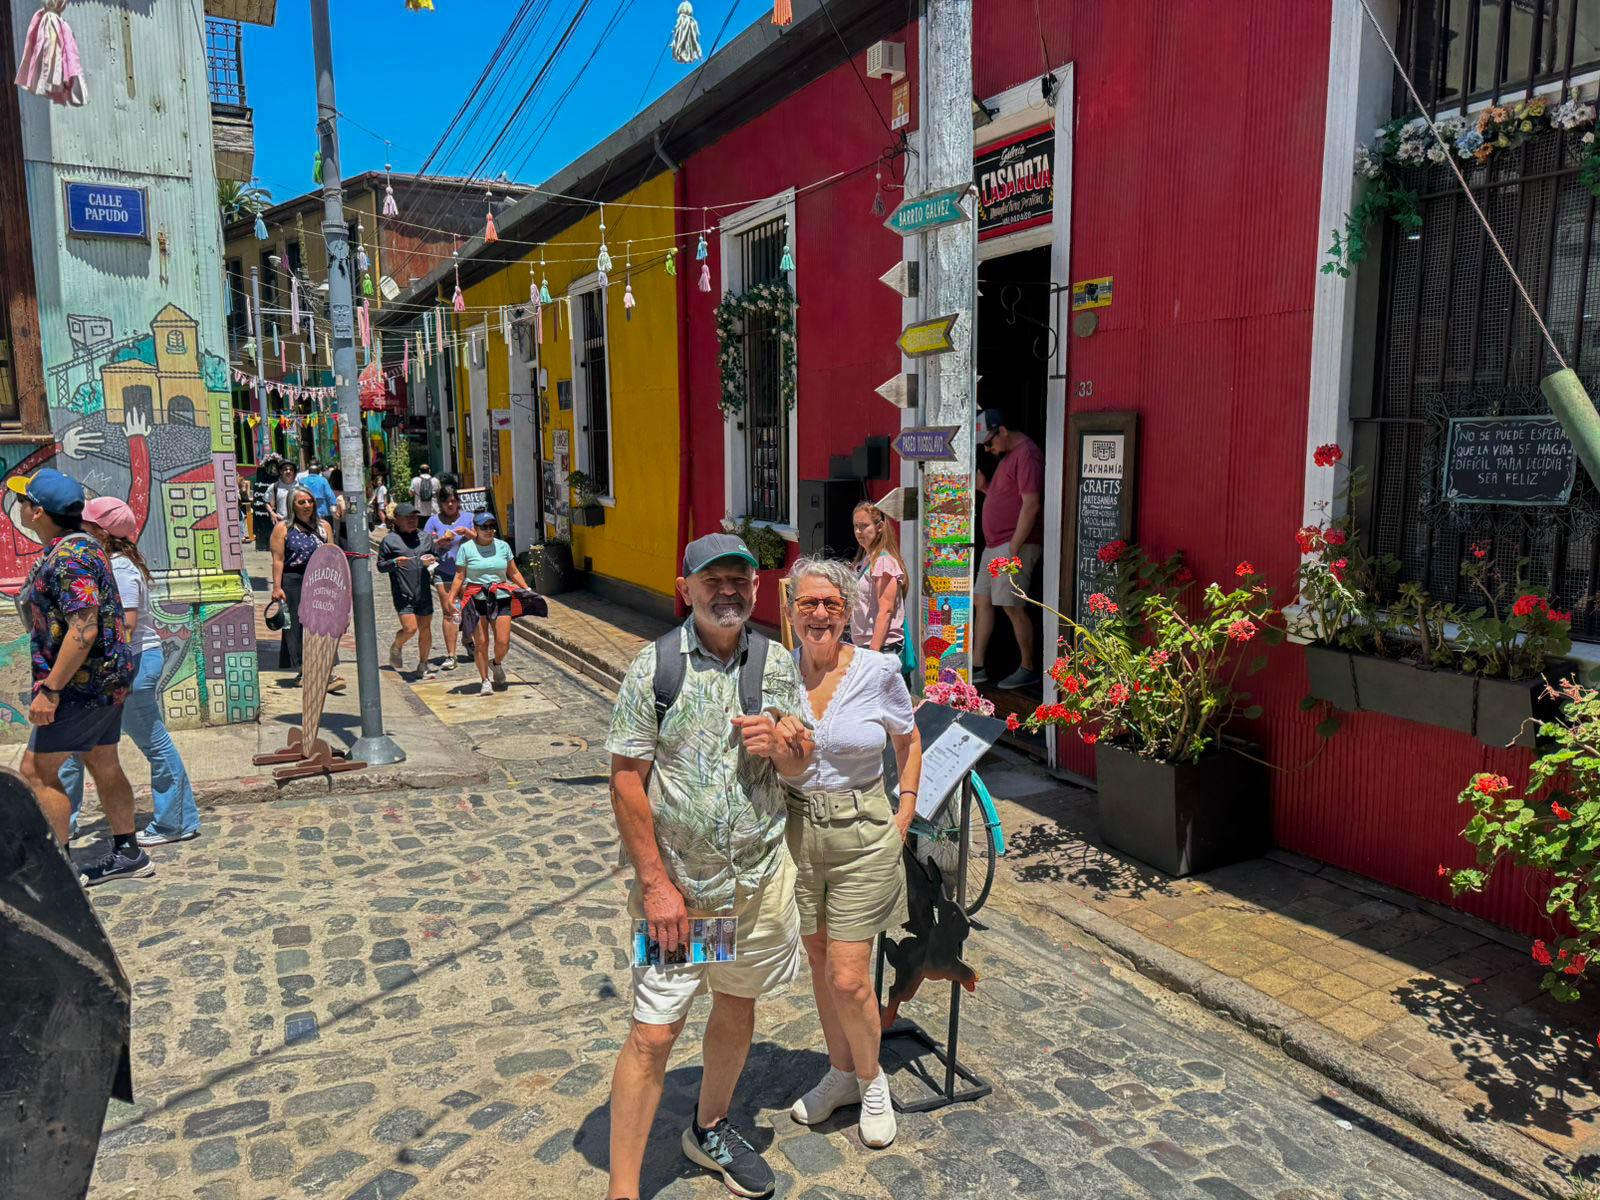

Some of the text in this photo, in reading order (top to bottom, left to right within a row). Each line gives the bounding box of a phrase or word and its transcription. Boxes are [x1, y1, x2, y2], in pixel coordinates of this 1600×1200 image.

[88, 193, 122, 207] CALLE
[85, 207, 129, 223] PAPUDO
[899, 199, 950, 227] BARRIO GALVEZ
[1459, 431, 1475, 441] NO
[1480, 431, 1490, 441] SE
[1495, 429, 1525, 441] PUEDE
[1456, 446, 1475, 457] QUE
[1478, 445, 1489, 456] LA
[1492, 443, 1514, 456] VIDA
[1537, 443, 1567, 456] HAGA
[1496, 457, 1522, 471] PARA
[1478, 472, 1498, 484] SER
[1083, 479, 1120, 494] CRAFTS
